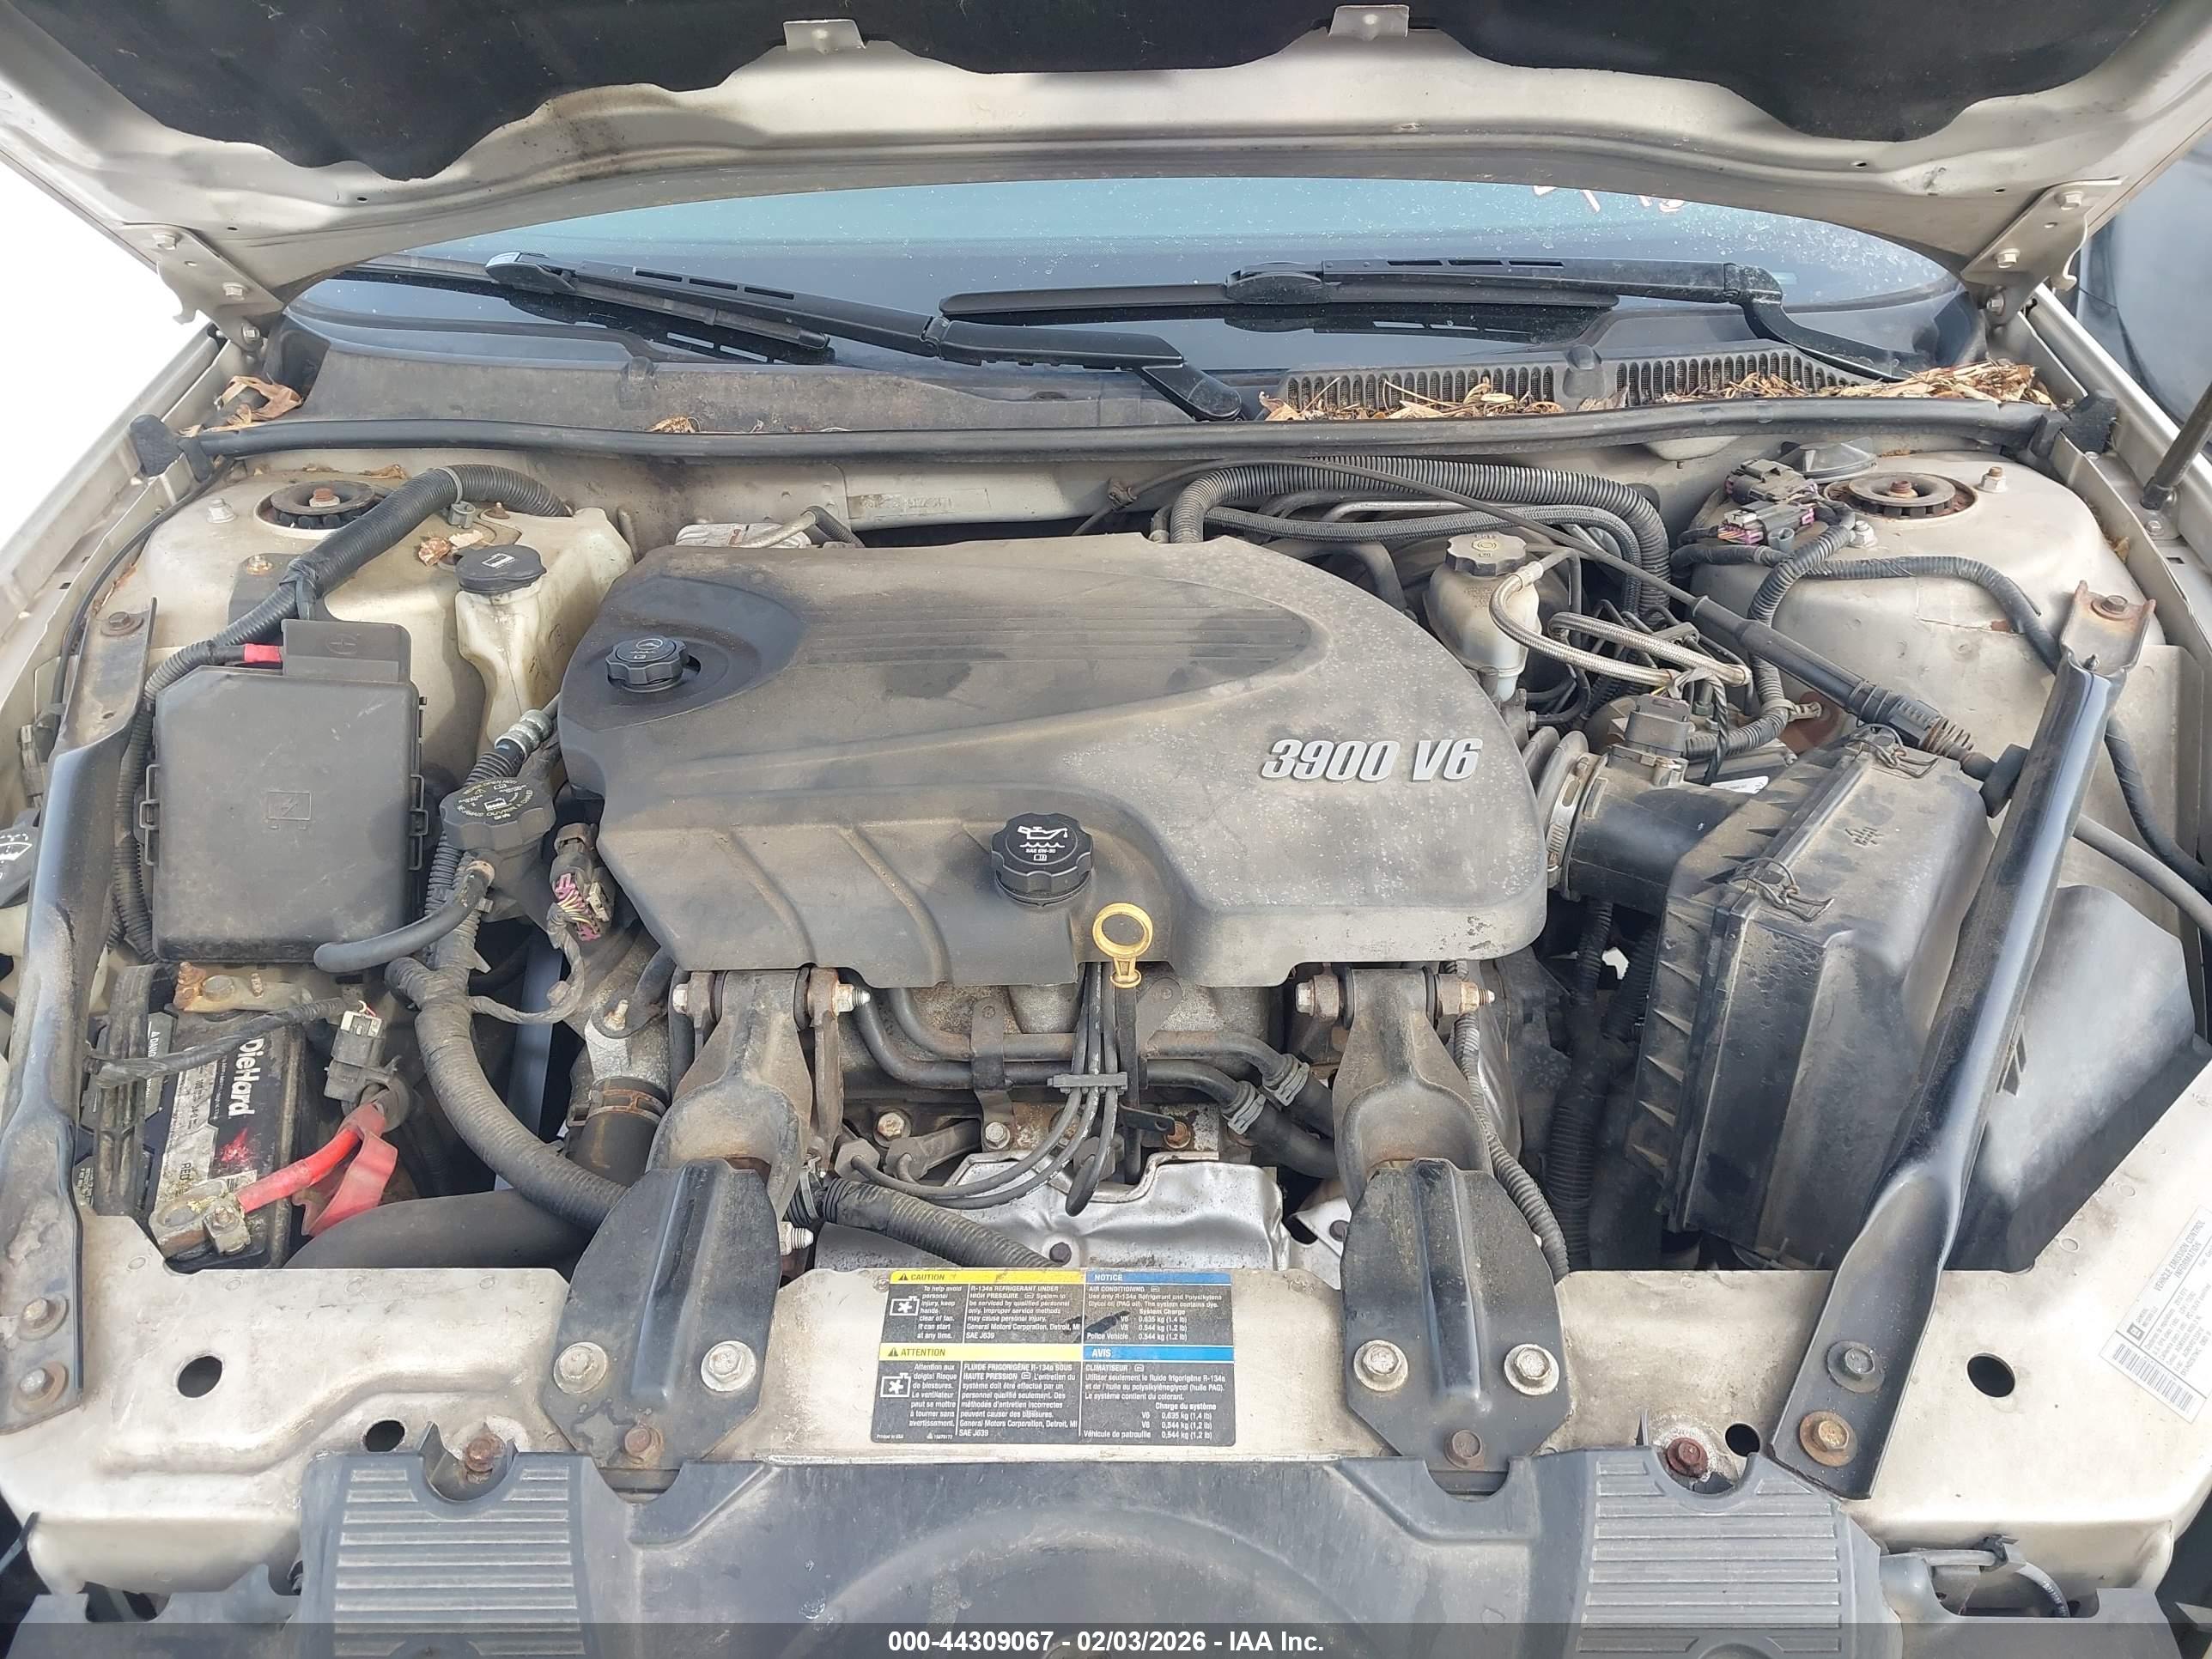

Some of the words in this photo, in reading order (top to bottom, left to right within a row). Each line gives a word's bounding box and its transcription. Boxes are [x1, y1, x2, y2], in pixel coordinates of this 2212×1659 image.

[1261, 738, 1401, 781] 3900
[1412, 738, 1484, 781] V6
[228, 1037, 264, 1117] DieHard
[2154, 1267, 2174, 1291] VEHICLE
[2169, 1243, 2189, 1271] EMISSION
[2185, 1219, 2205, 1245] CONTROL
[2173, 1242, 2202, 1279] INFORMATION
[1092, 1348, 1112, 1357] AVIS
[1168, 1374, 1201, 1382] frigorigène
[1189, 1383, 1206, 1392] (huile
[1208, 1383, 1224, 1392] PAG).
[1006, 1419, 1044, 1428] Corporation,
[1180, 1421, 1188, 1430] kg
[1189, 1421, 1202, 1430] (1,2
[1203, 1421, 1212, 1430] lb)
[1180, 1431, 1188, 1439] kg
[1189, 1431, 1202, 1439] (1,2
